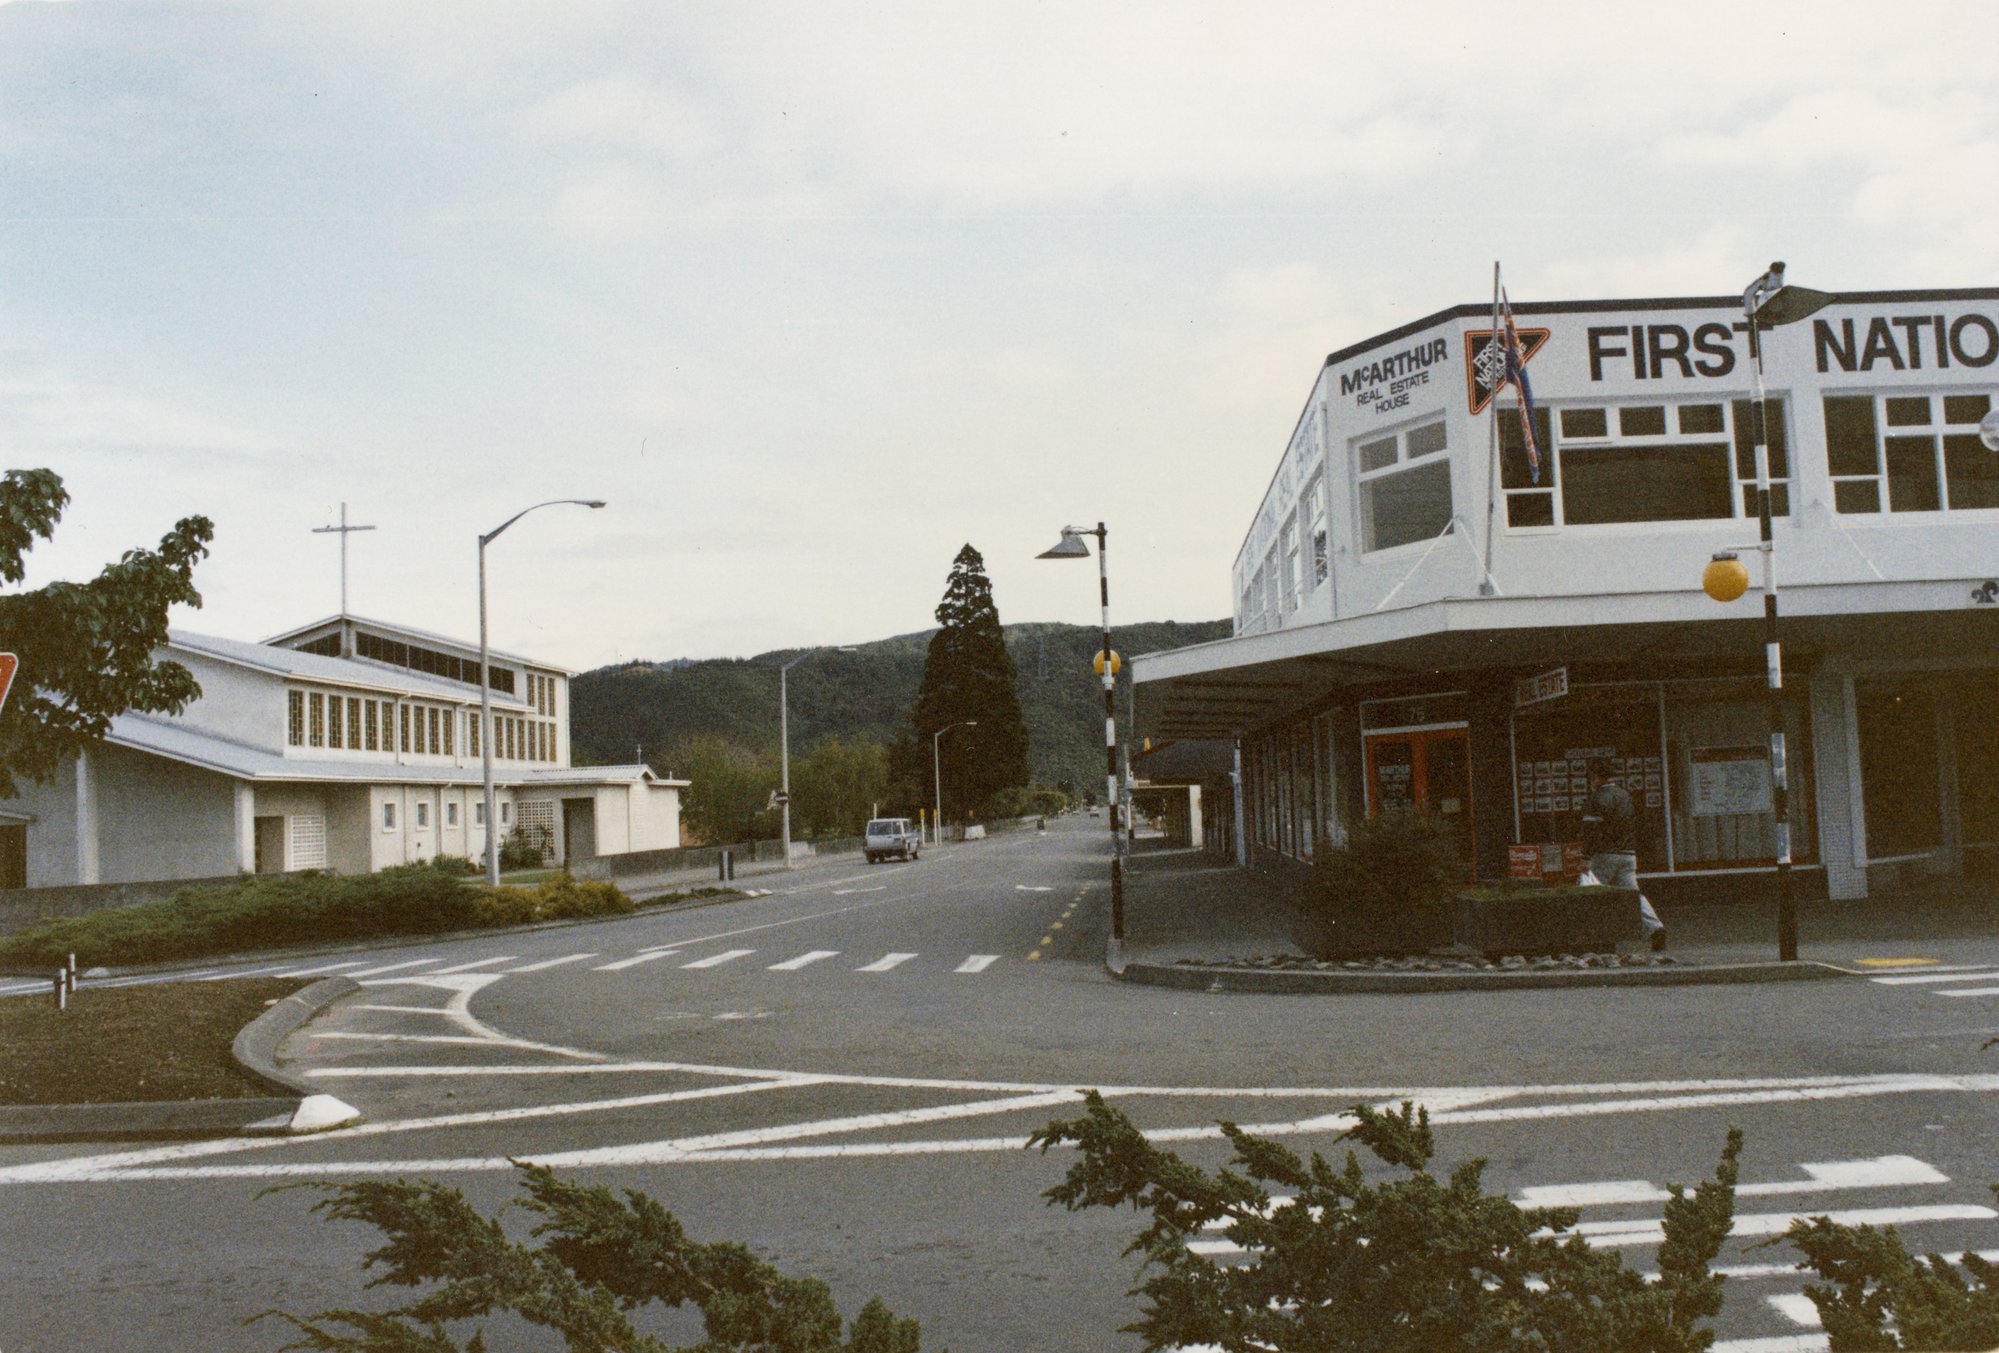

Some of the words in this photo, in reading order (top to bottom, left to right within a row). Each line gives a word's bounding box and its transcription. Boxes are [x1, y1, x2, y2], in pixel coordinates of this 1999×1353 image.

[1587, 321, 1774, 381] FIRST
[1813, 313, 1999, 373] NATIO
[1357, 388, 1384, 407] REAL
[1390, 371, 1430, 395] ESTATE
[1375, 393, 1410, 414] HOUSE
